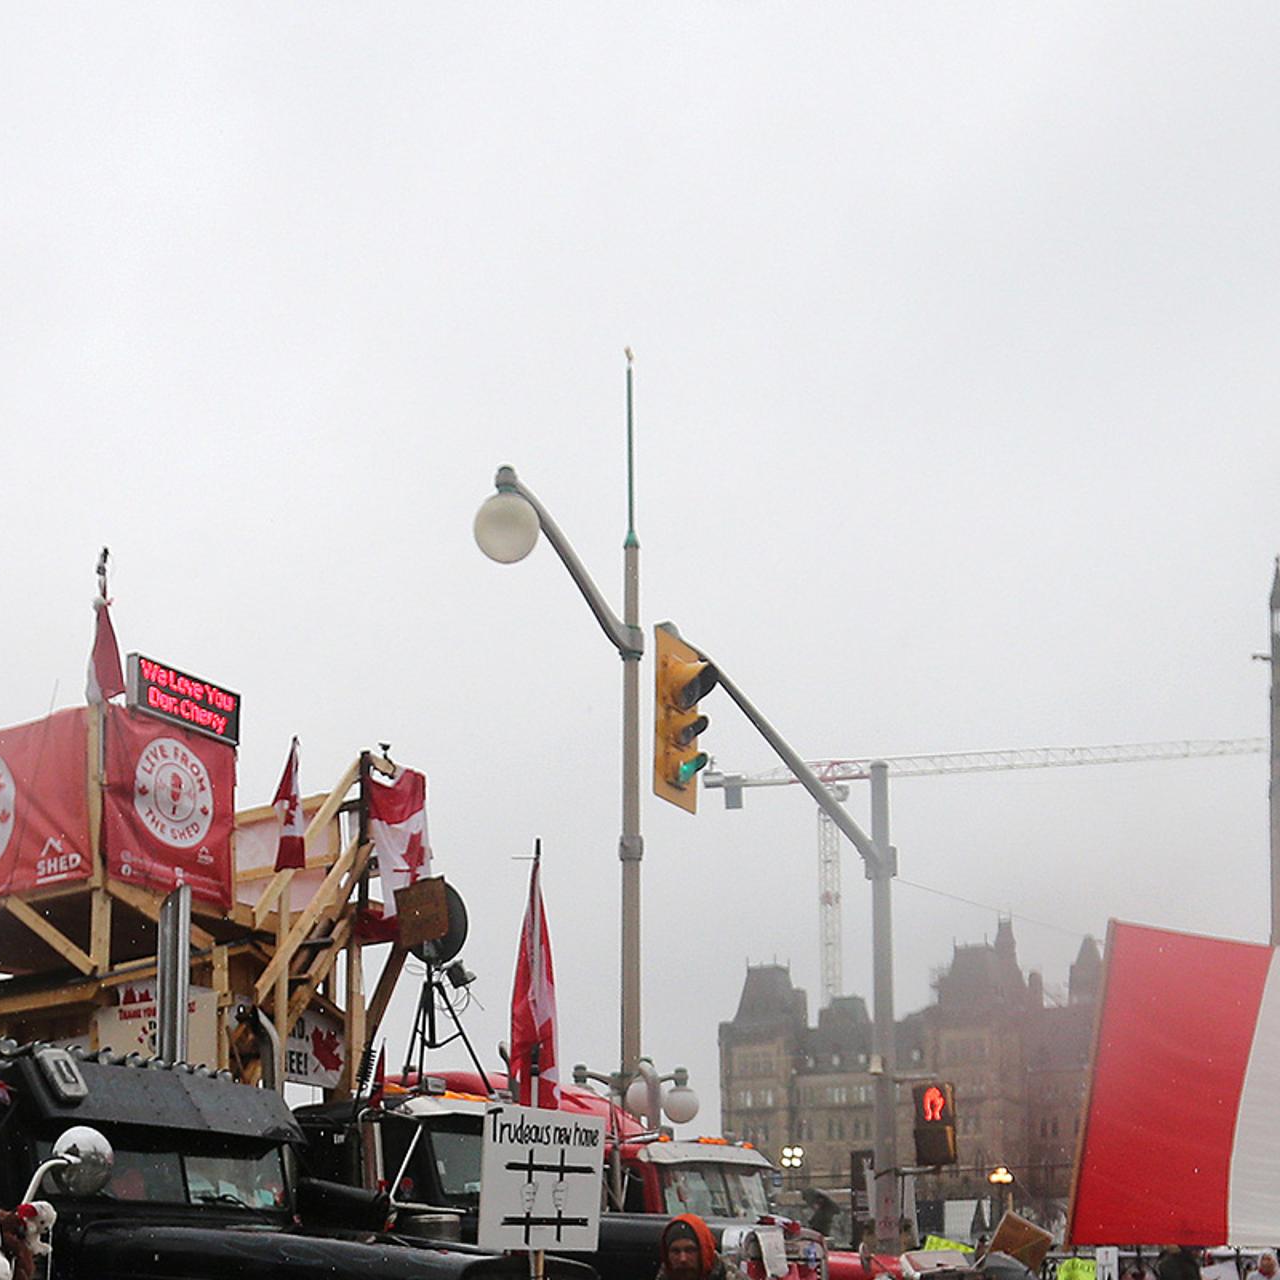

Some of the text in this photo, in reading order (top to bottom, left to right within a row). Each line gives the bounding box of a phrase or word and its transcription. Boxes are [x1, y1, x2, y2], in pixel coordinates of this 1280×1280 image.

[168, 671, 203, 700] Love
[204, 685, 236, 712] You
[141, 745, 207, 793] LIVE FROM
[145, 806, 201, 841] THE SHED
[36, 853, 82, 876] SHED
[285, 1051, 308, 1075] EE!
[487, 1107, 551, 1146] Trudeaus
[573, 1121, 600, 1147] home
